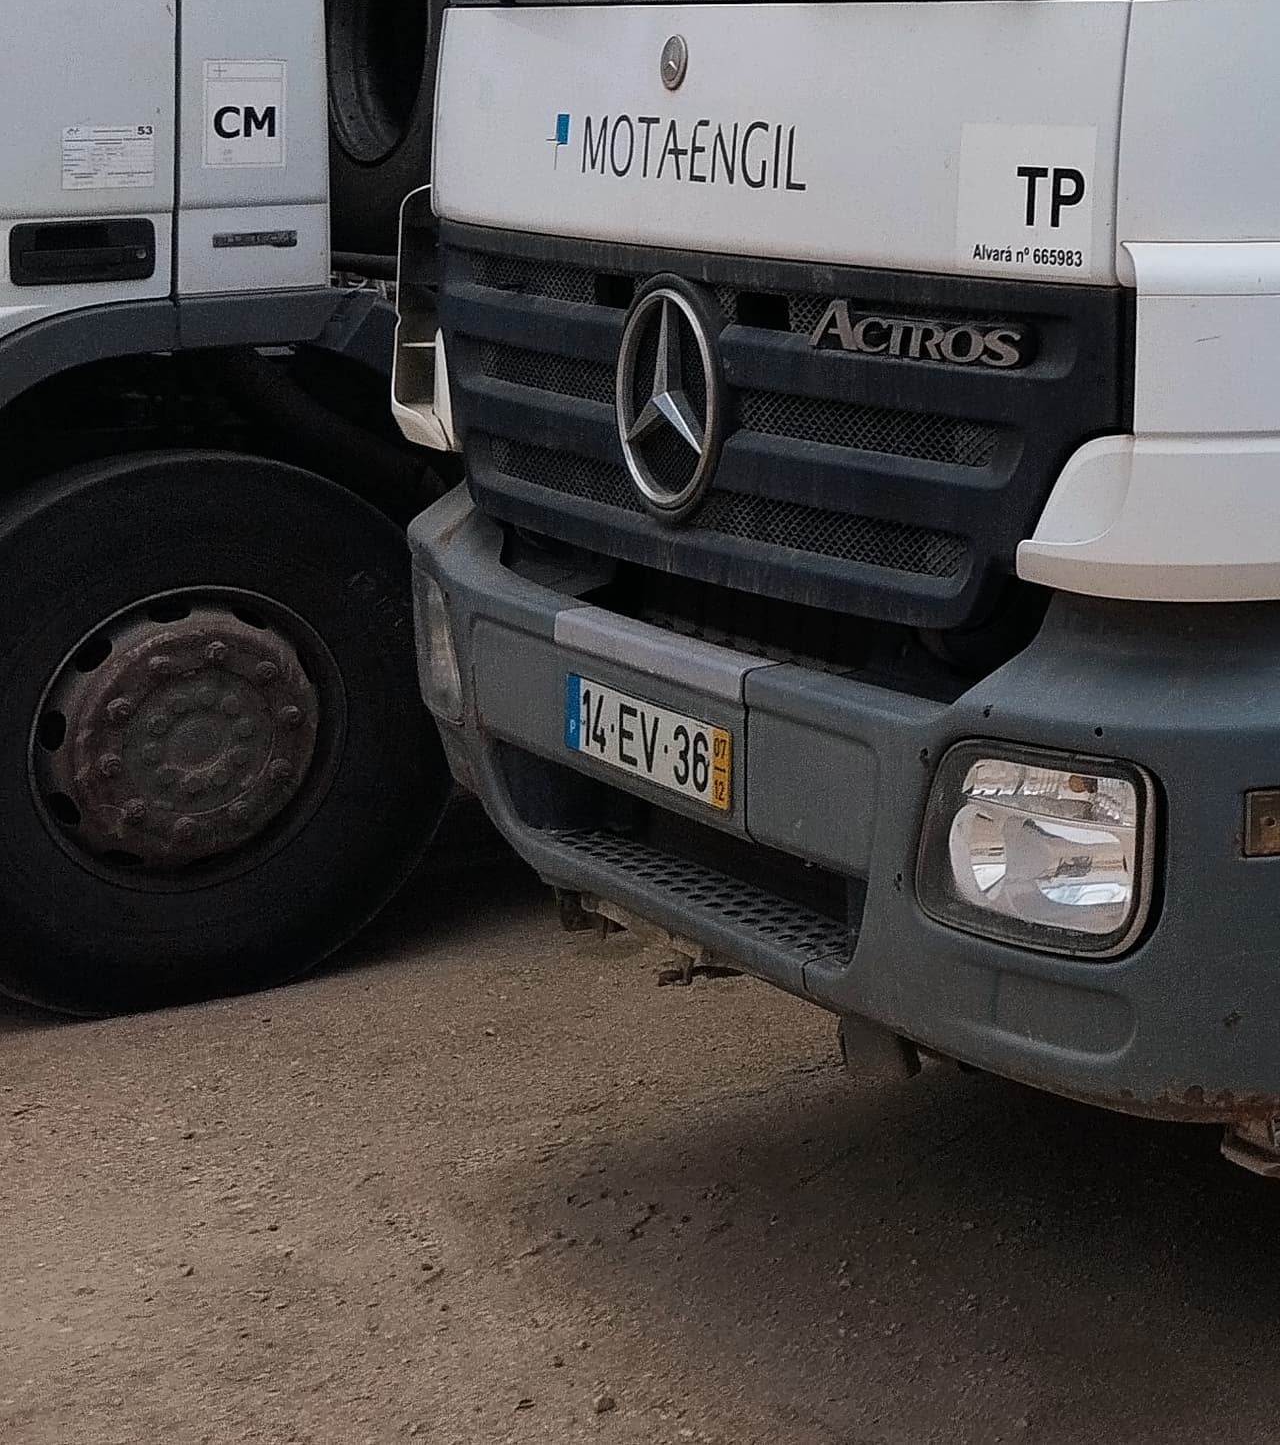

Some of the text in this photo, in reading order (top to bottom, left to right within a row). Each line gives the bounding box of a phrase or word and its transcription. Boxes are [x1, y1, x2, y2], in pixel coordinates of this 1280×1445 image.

[137, 126, 153, 135] 53
[213, 106, 277, 138] CM
[1017, 166, 1085, 227] TP
[973, 244, 1083, 267] Alvará nº 665983
